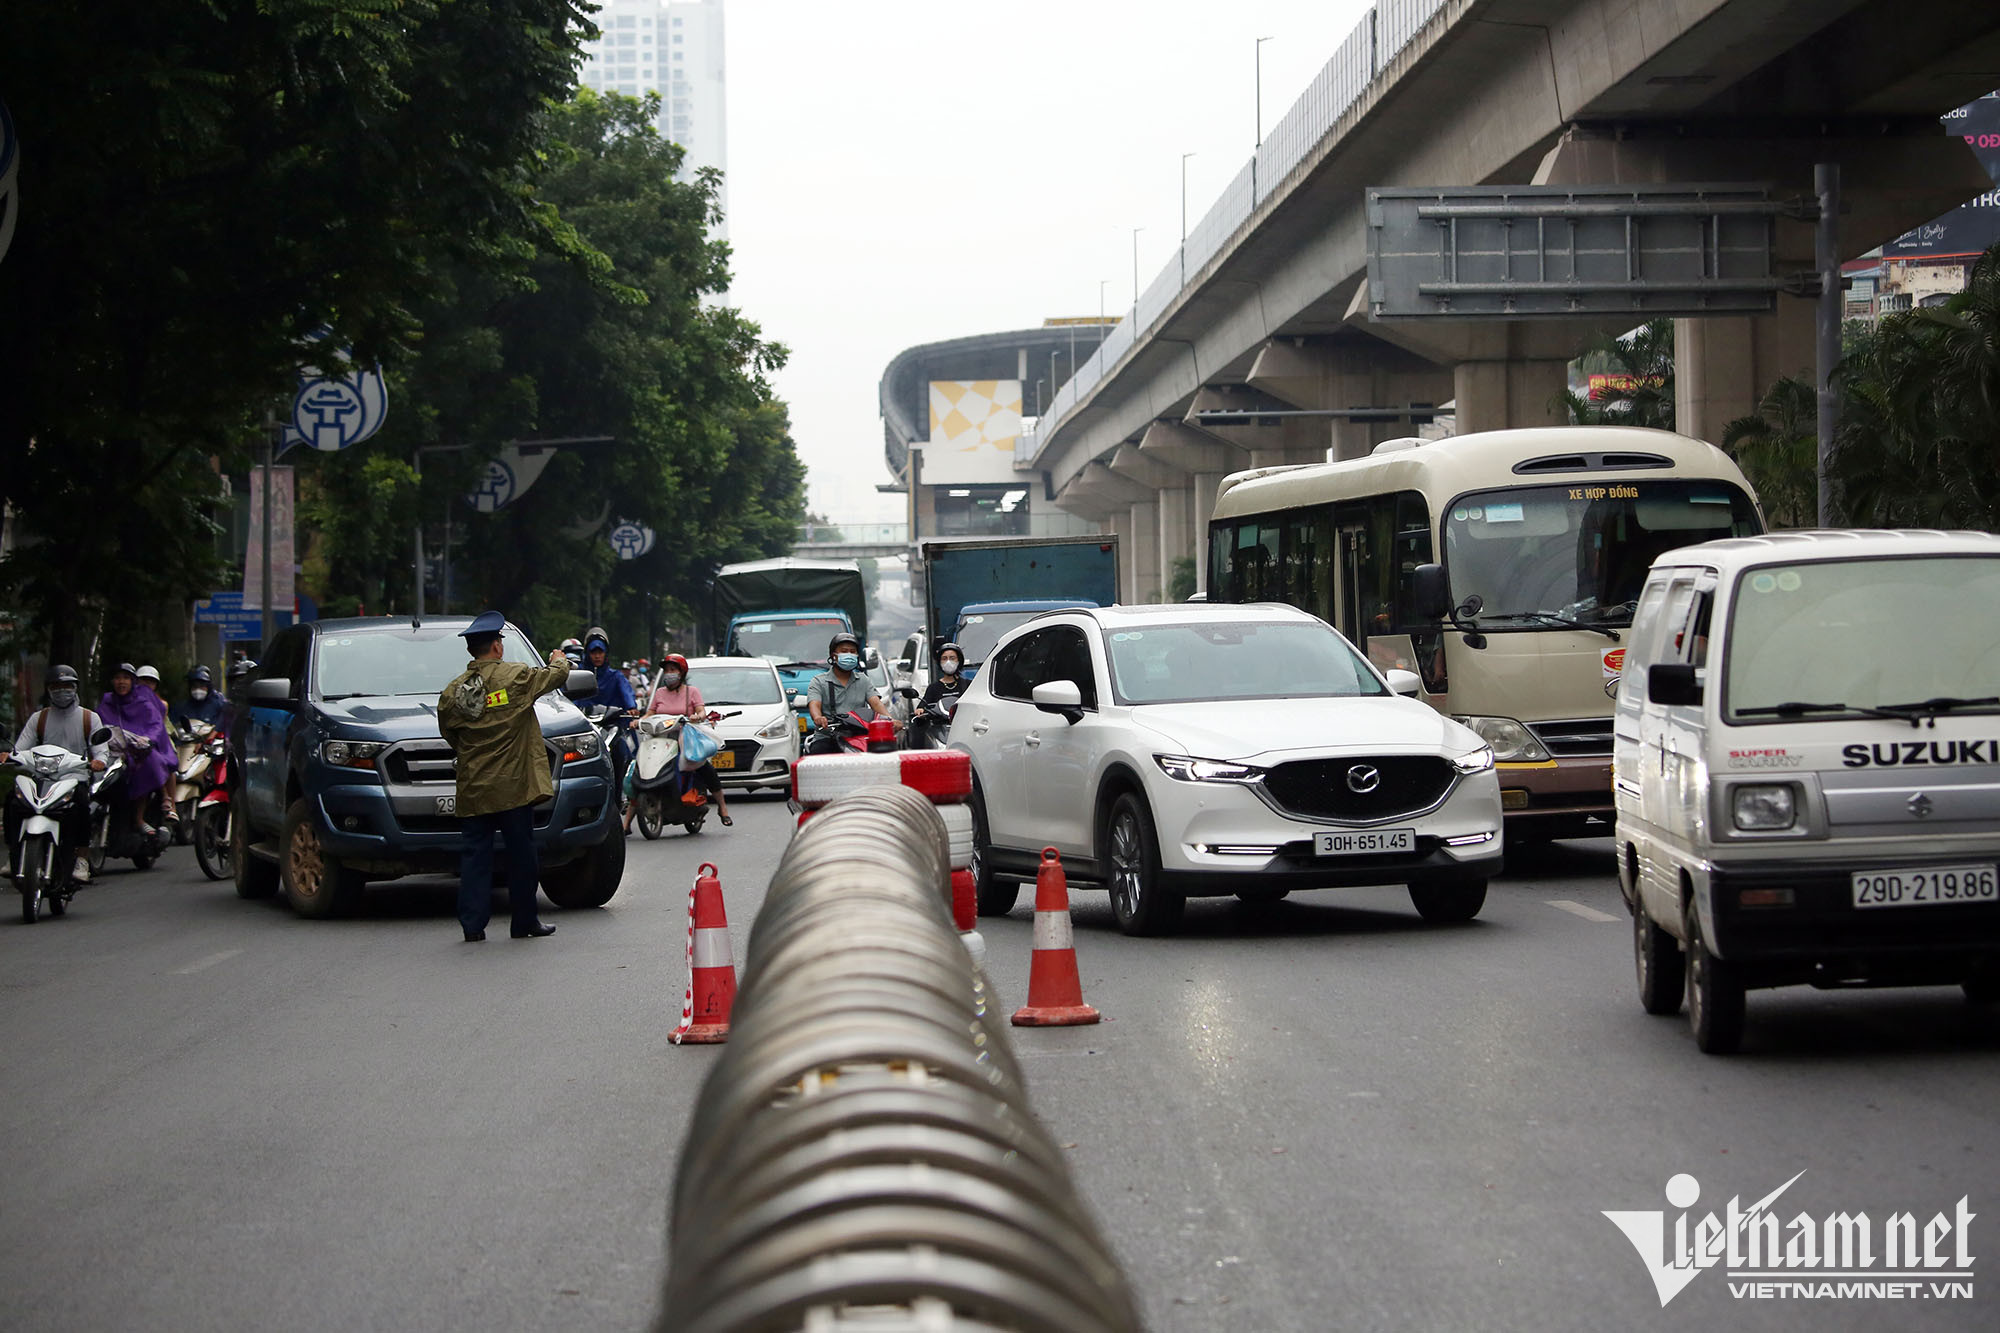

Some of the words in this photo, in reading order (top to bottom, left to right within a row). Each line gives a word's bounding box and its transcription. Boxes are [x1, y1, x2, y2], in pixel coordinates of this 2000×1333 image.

[1568, 489, 1583, 500] XE
[1585, 487, 1606, 501] HỢP
[1609, 484, 1639, 499] ĐỒNG
[1729, 748, 1787, 758] SUPER
[1842, 739, 2000, 767] SUZUKI
[1728, 755, 1803, 769] CARRY
[1324, 833, 1407, 851] 30H-651.45
[1857, 871, 1994, 905] 29D-219.86
